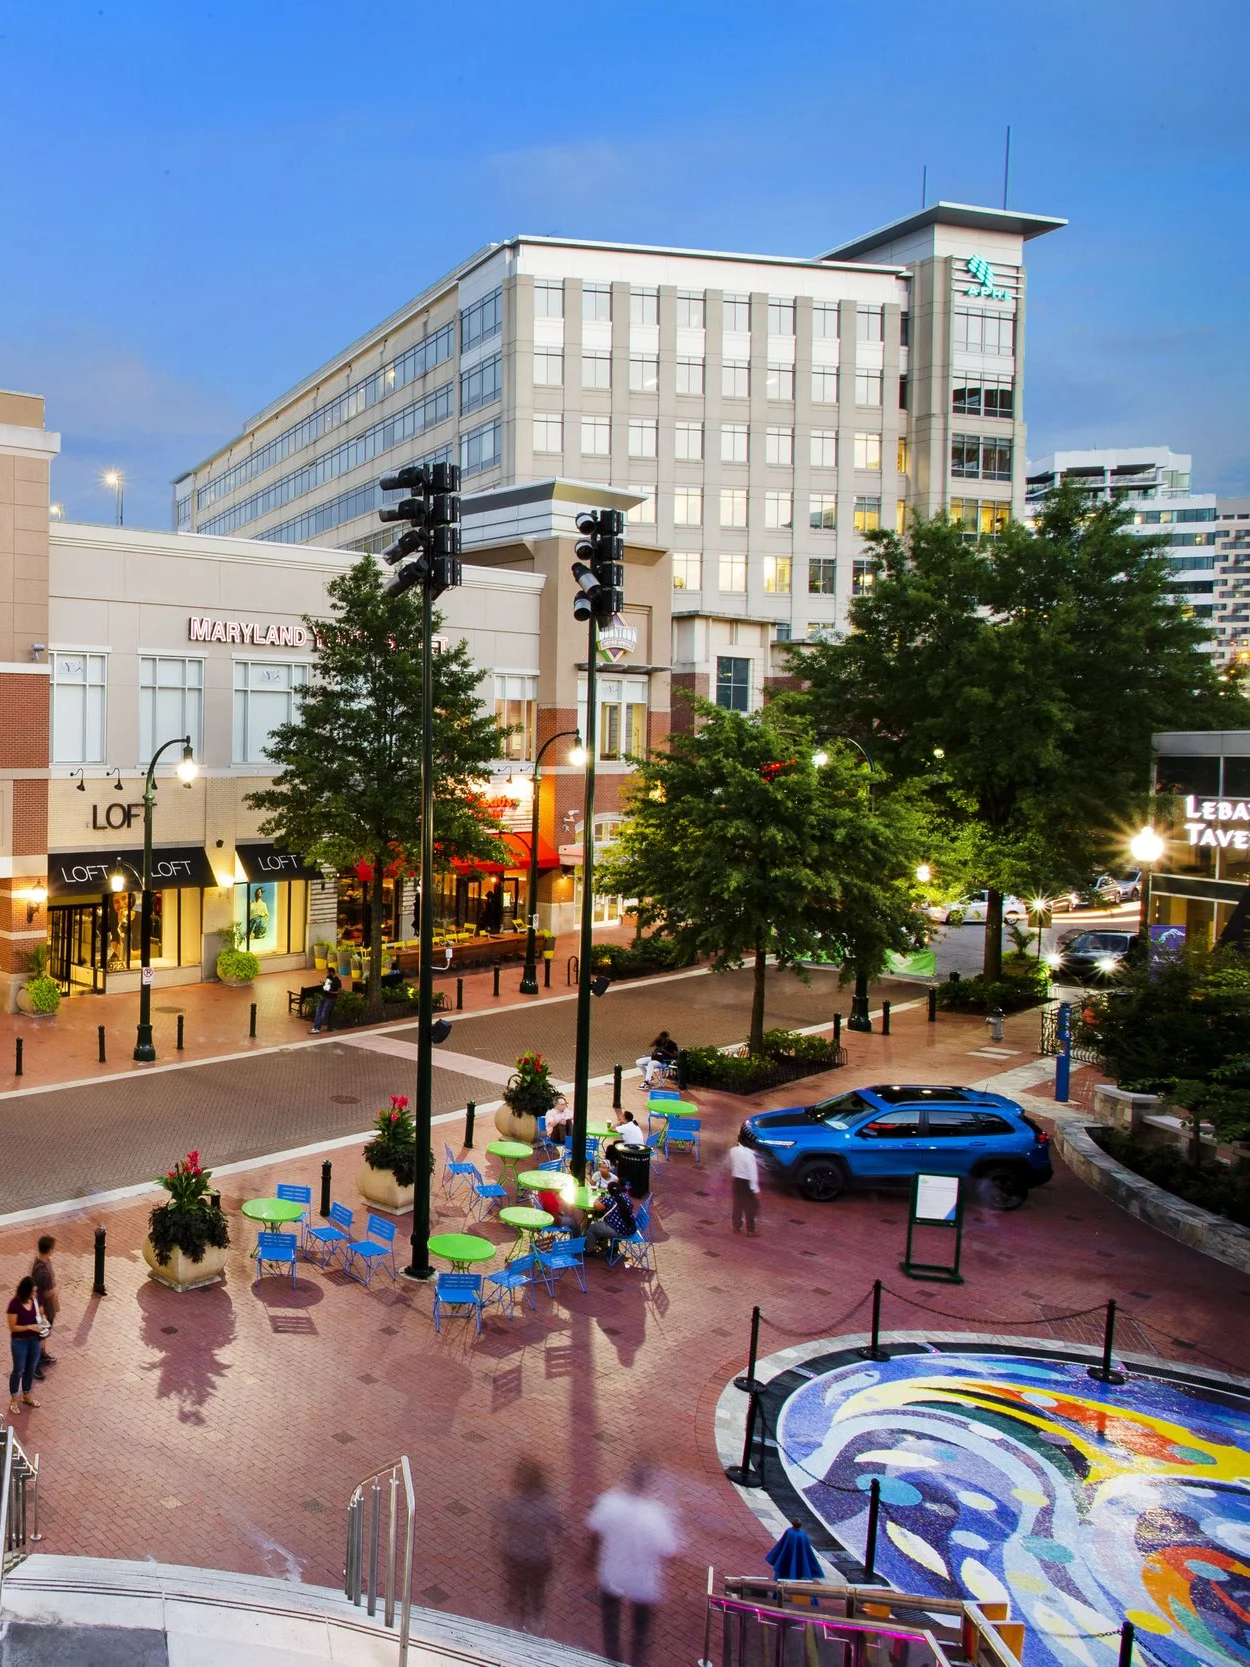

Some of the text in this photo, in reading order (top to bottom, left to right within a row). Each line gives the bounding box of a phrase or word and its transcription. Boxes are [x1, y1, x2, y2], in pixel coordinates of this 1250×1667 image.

[967, 285, 1012, 300] APHL
[188, 616, 307, 648] MARYLAND
[1185, 794, 1250, 820] LEBA
[1183, 823, 1250, 849] TAVE
[258, 854, 297, 870] LOFT
[61, 864, 109, 884] LOFT
